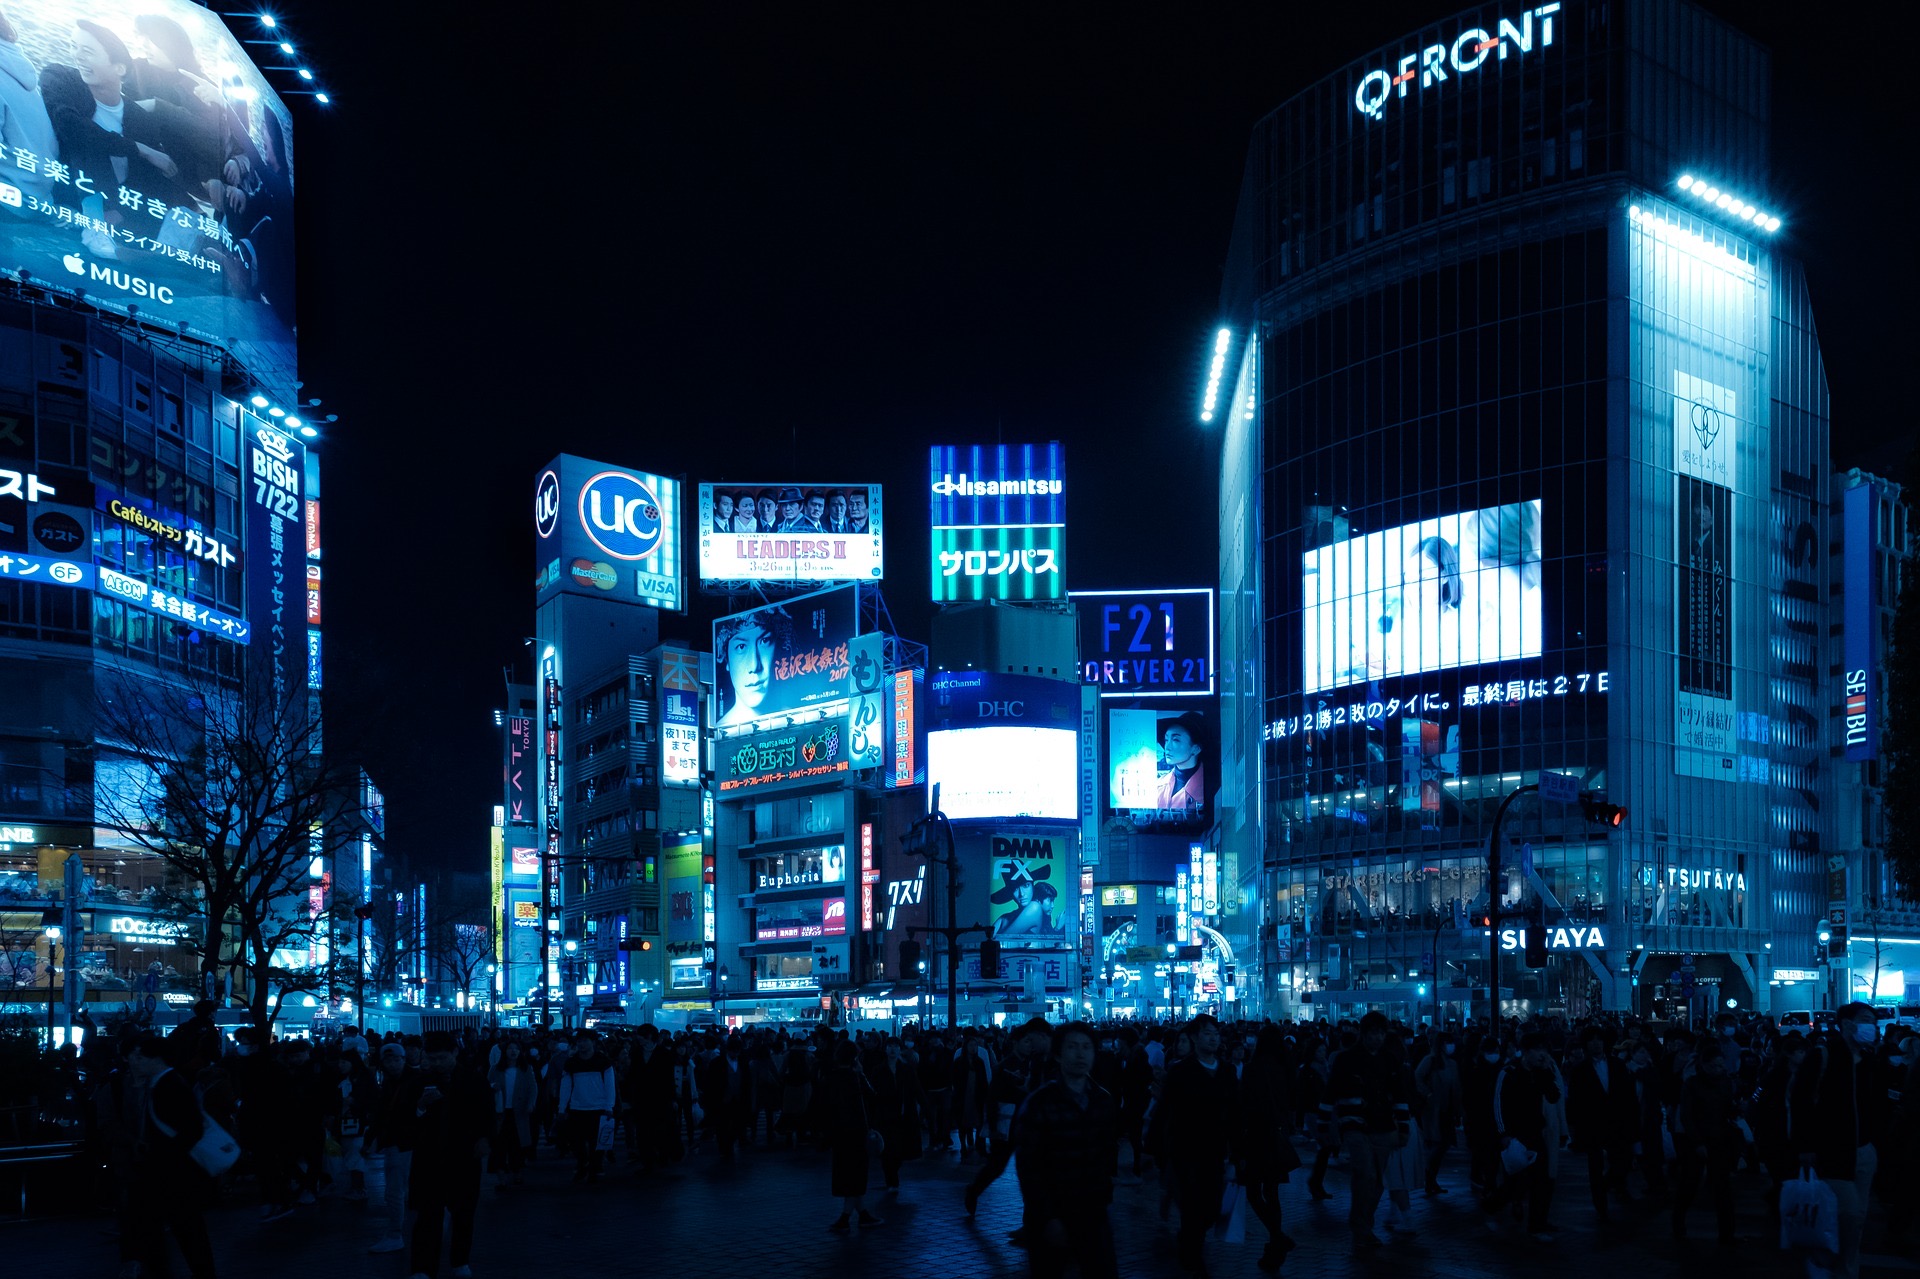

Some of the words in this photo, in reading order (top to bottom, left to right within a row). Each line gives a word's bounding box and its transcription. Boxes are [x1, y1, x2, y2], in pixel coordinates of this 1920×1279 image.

[0, 140, 250, 270] 音楽と、好きな場所へ。
[90, 262, 174, 305] MUSIC
[932, 474, 1062, 496] Hisamitsu
[253, 477, 299, 523] 7/22
[871, 486, 880, 557] 日本車の未来は
[40, 527, 80, 543] ガスト
[185, 528, 236, 568] ガスト
[736, 540, 830, 560] LEADERS
[938, 549, 1059, 576] サロンパス
[53, 566, 78, 580] 6F
[641, 579, 676, 596] VISA
[105, 575, 142, 601] AEON
[150, 588, 248, 638] 英会話イーオン
[1103, 602, 1175, 653] F21
[663, 652, 698, 691] 本
[829, 666, 849, 682] 2017
[932, 680, 949, 690] DHC
[950, 678, 981, 688] Channel
[1077, 660, 1176, 685] OREVER
[1181, 658, 1205, 683] 21
[850, 649, 881, 763] もんじゃ
[978, 701, 1024, 718] DHC
[1083, 704, 1096, 764] Taisei
[679, 757, 697, 769] 地下
[759, 745, 796, 771] 西村
[1082, 768, 1094, 817] neon
[992, 838, 1054, 859] DMM
[759, 872, 820, 889] Euphoria
[992, 859, 1033, 881] FX
[1667, 867, 1746, 892] TSUTAYA
[824, 901, 845, 920] JTB
[886, 865, 926, 931] クスリ
